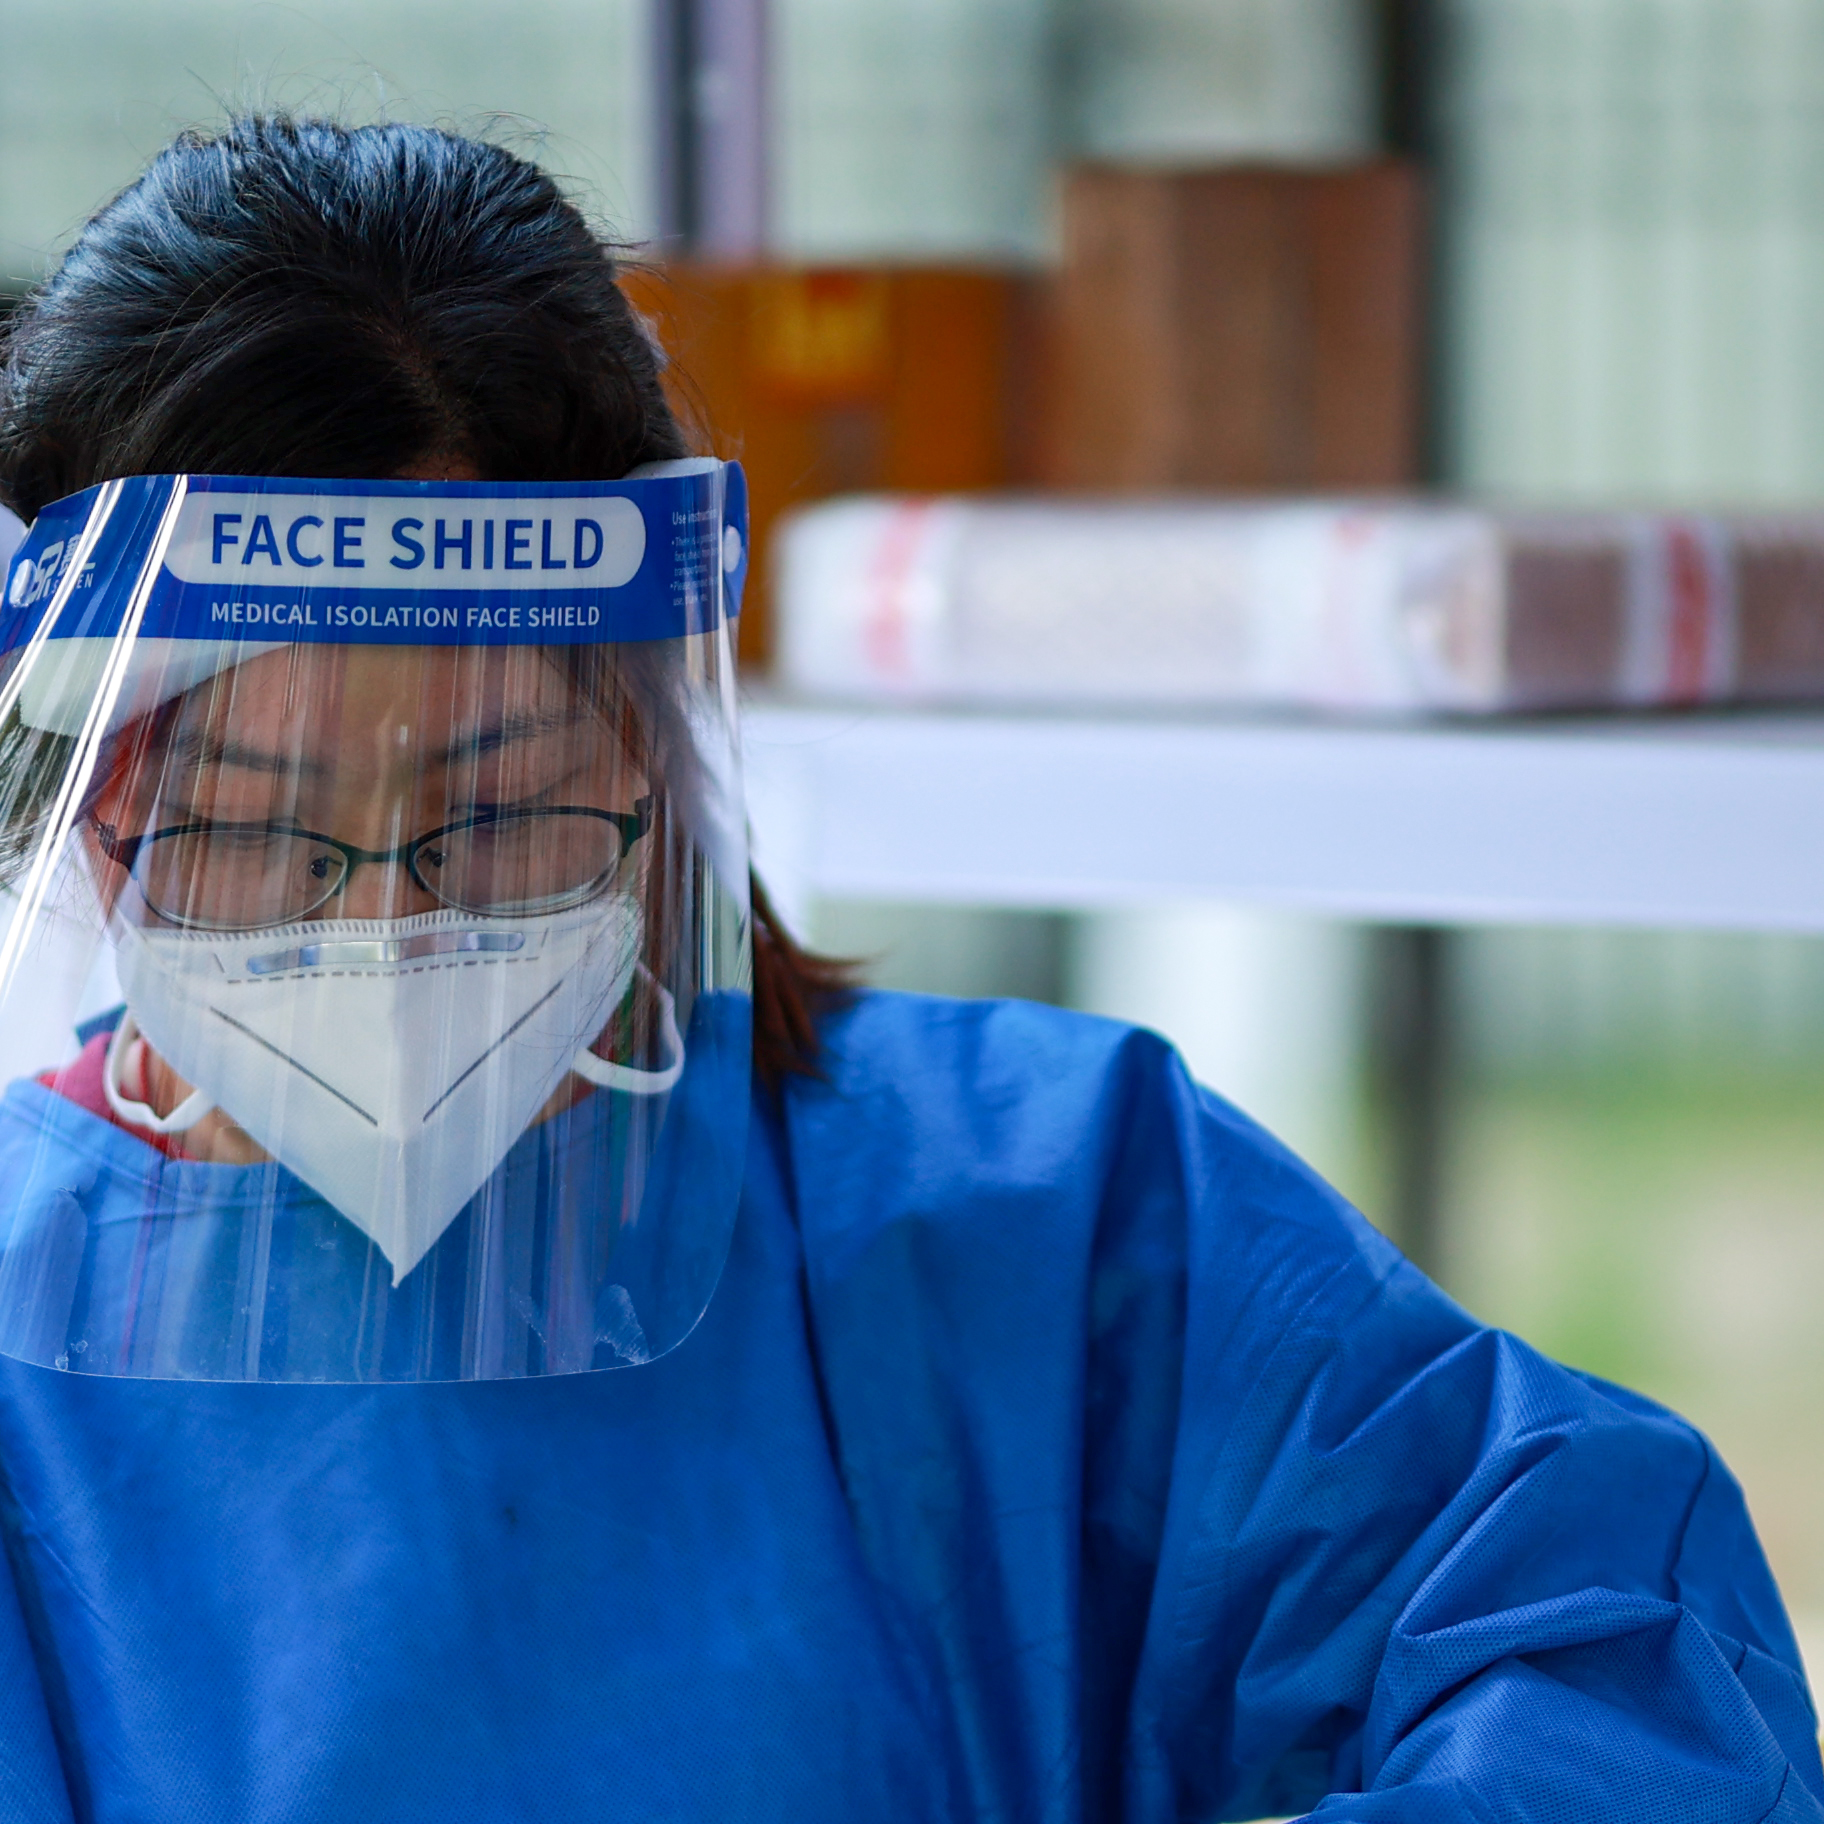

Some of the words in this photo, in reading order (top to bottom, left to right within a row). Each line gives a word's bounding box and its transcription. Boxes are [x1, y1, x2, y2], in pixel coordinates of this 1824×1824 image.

[212, 513, 366, 569] FACE
[389, 516, 604, 571] SHIELD
[211, 601, 318, 626] MEDICAL
[326, 605, 459, 629] ISOLATION
[466, 607, 522, 629] FACE
[528, 605, 601, 628] SHIELD
